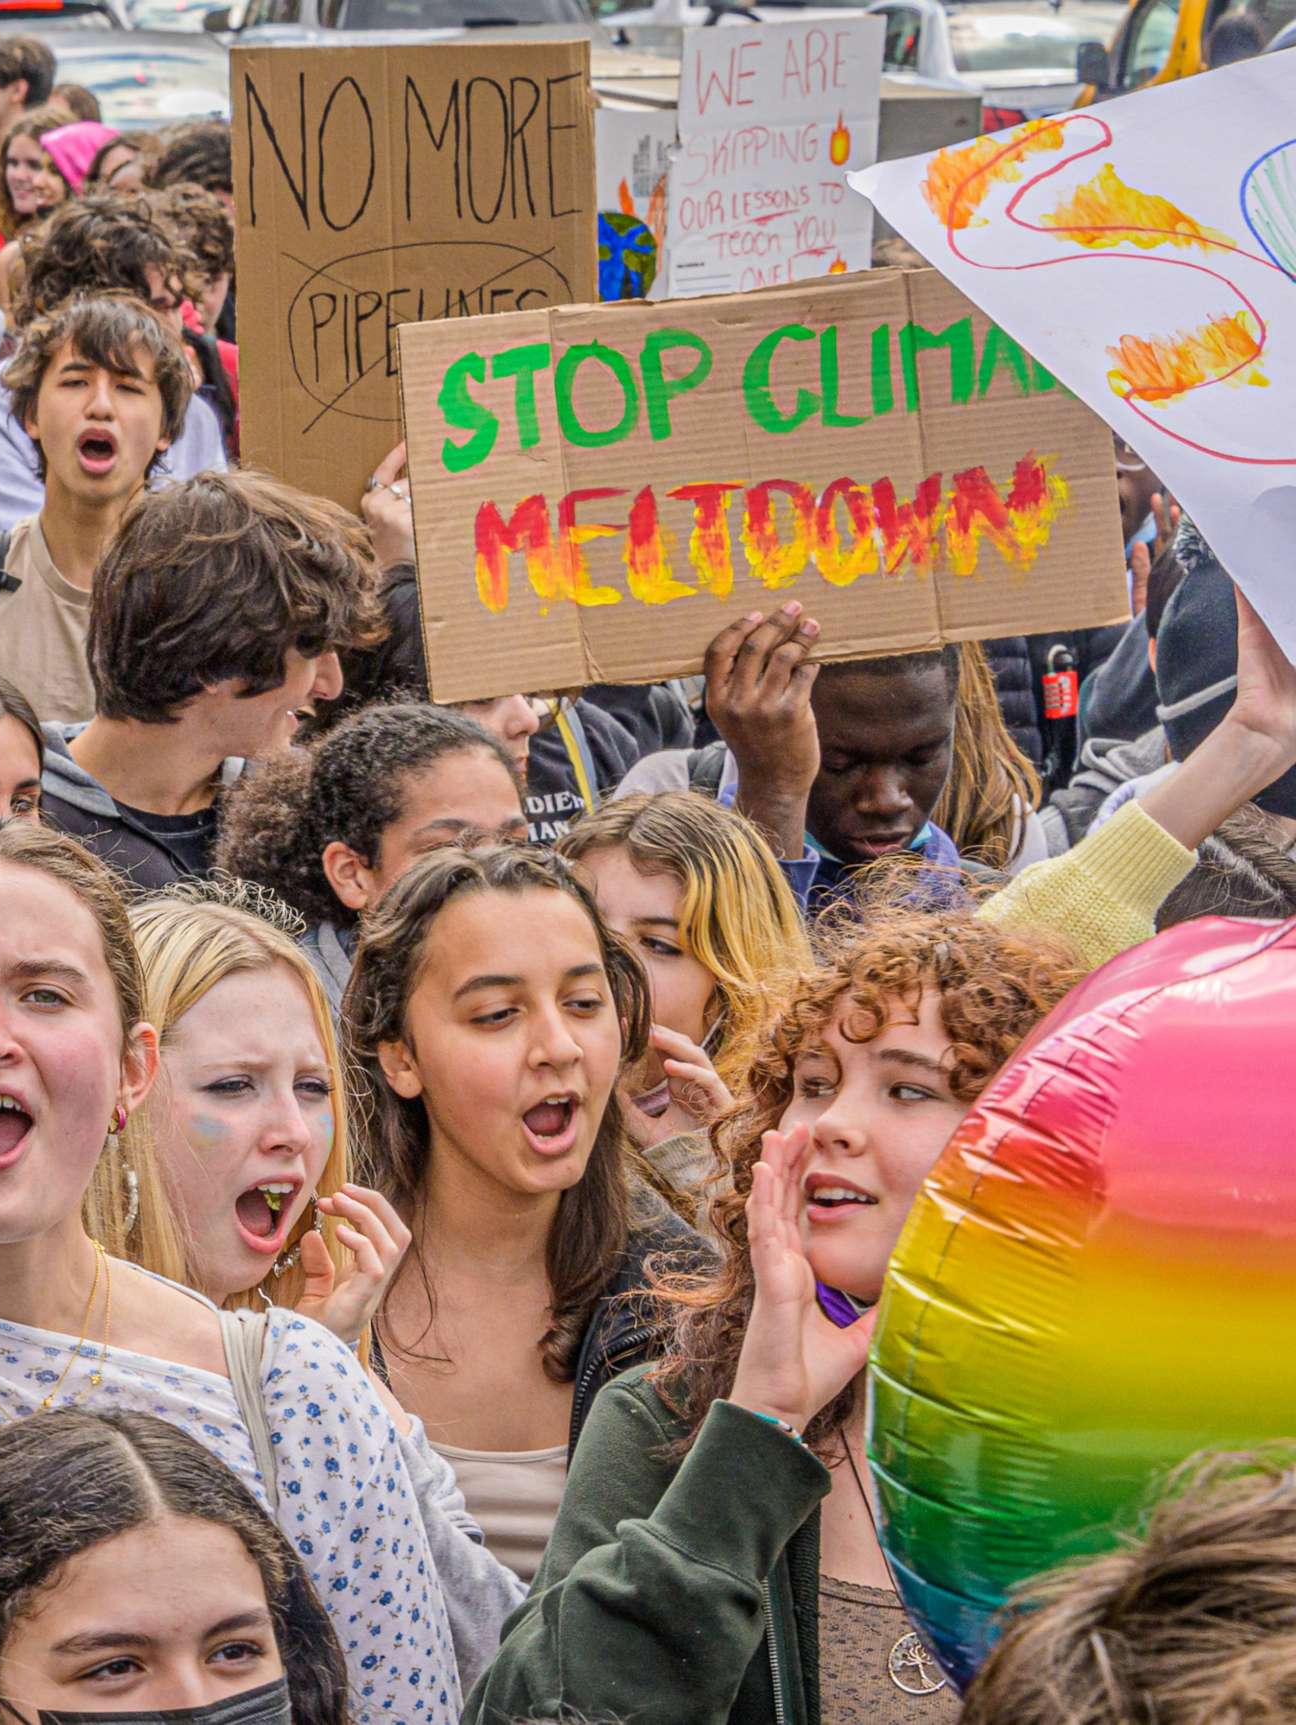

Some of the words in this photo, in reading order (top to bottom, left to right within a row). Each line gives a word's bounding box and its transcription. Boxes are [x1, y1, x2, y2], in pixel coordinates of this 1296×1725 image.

[695, 40, 763, 115] WE
[782, 27, 852, 98] ARE
[244, 71, 375, 231] NO
[405, 71, 584, 224] MORE
[680, 122, 818, 188] SKIPPING
[678, 189, 726, 232] OUR
[731, 184, 812, 220] LESSONS
[818, 182, 846, 205] TO
[793, 215, 837, 250] YOU
[437, 325, 714, 473] STOP
[474, 448, 1071, 616] MELTDOWN
